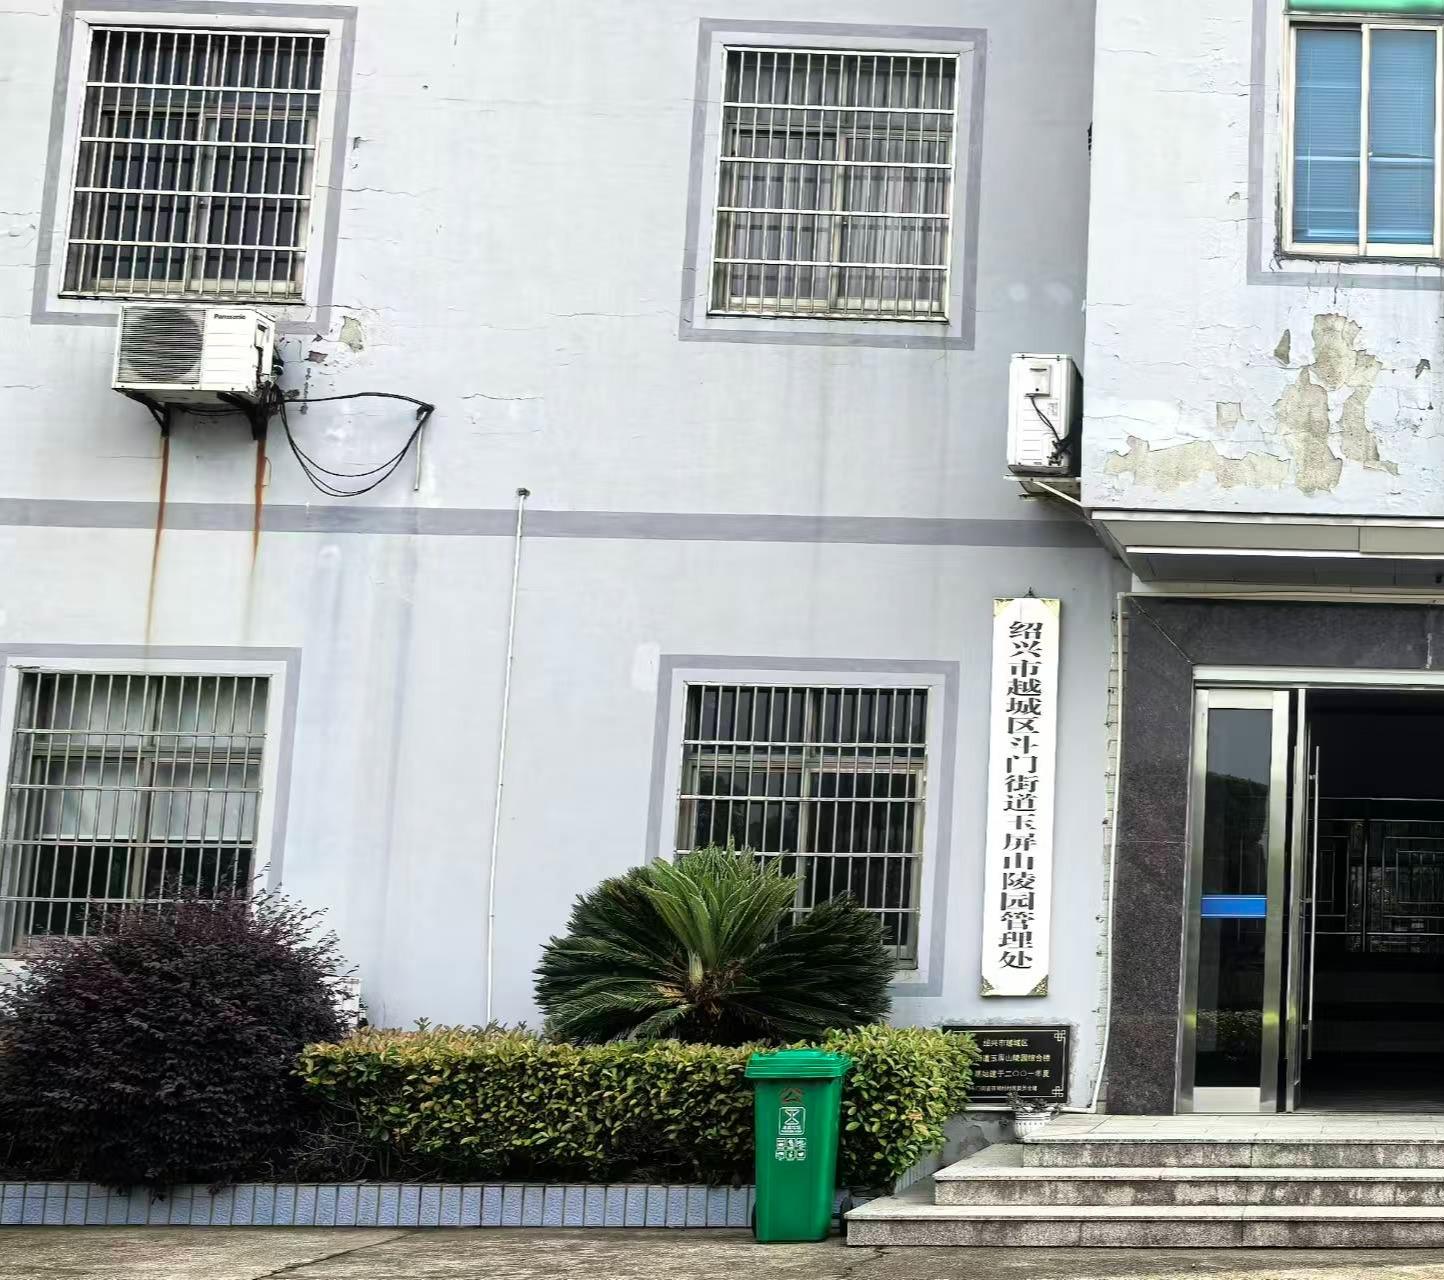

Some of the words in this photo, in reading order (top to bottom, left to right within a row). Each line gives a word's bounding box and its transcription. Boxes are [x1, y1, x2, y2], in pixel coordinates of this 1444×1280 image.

[998, 620, 1044, 970] 绍兴市越城区斗门街道玉屏山陵园管理处
